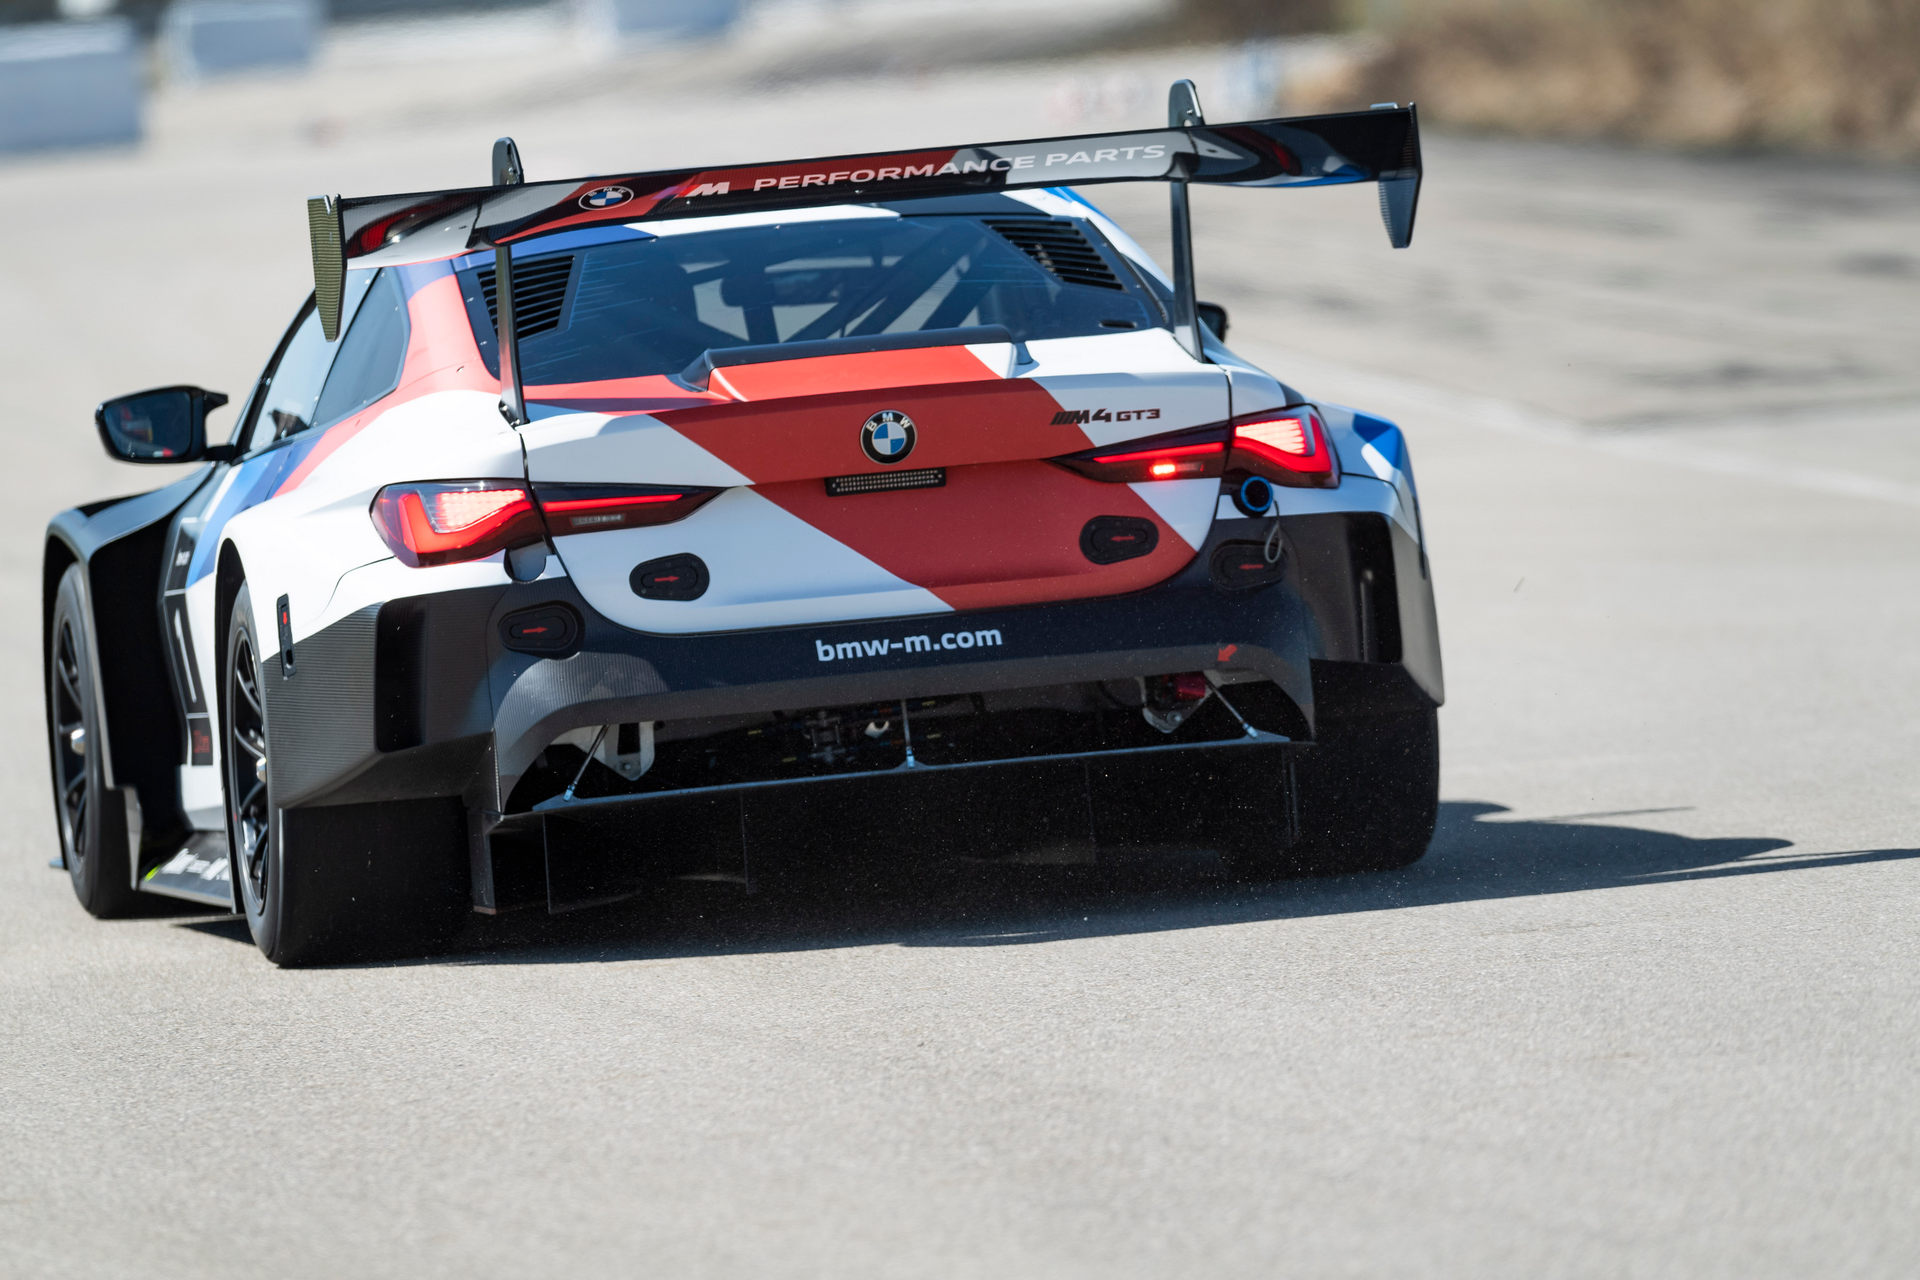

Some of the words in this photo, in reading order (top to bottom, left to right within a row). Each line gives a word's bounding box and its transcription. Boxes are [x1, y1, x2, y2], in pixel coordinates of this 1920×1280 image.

[684, 181, 730, 198] M
[753, 157, 1034, 192] PERFORMANCE
[1045, 144, 1166, 167] PARTS
[866, 412, 911, 431] BMW
[1116, 408, 1160, 422] GT3
[815, 628, 1003, 662] bmw-m.com
